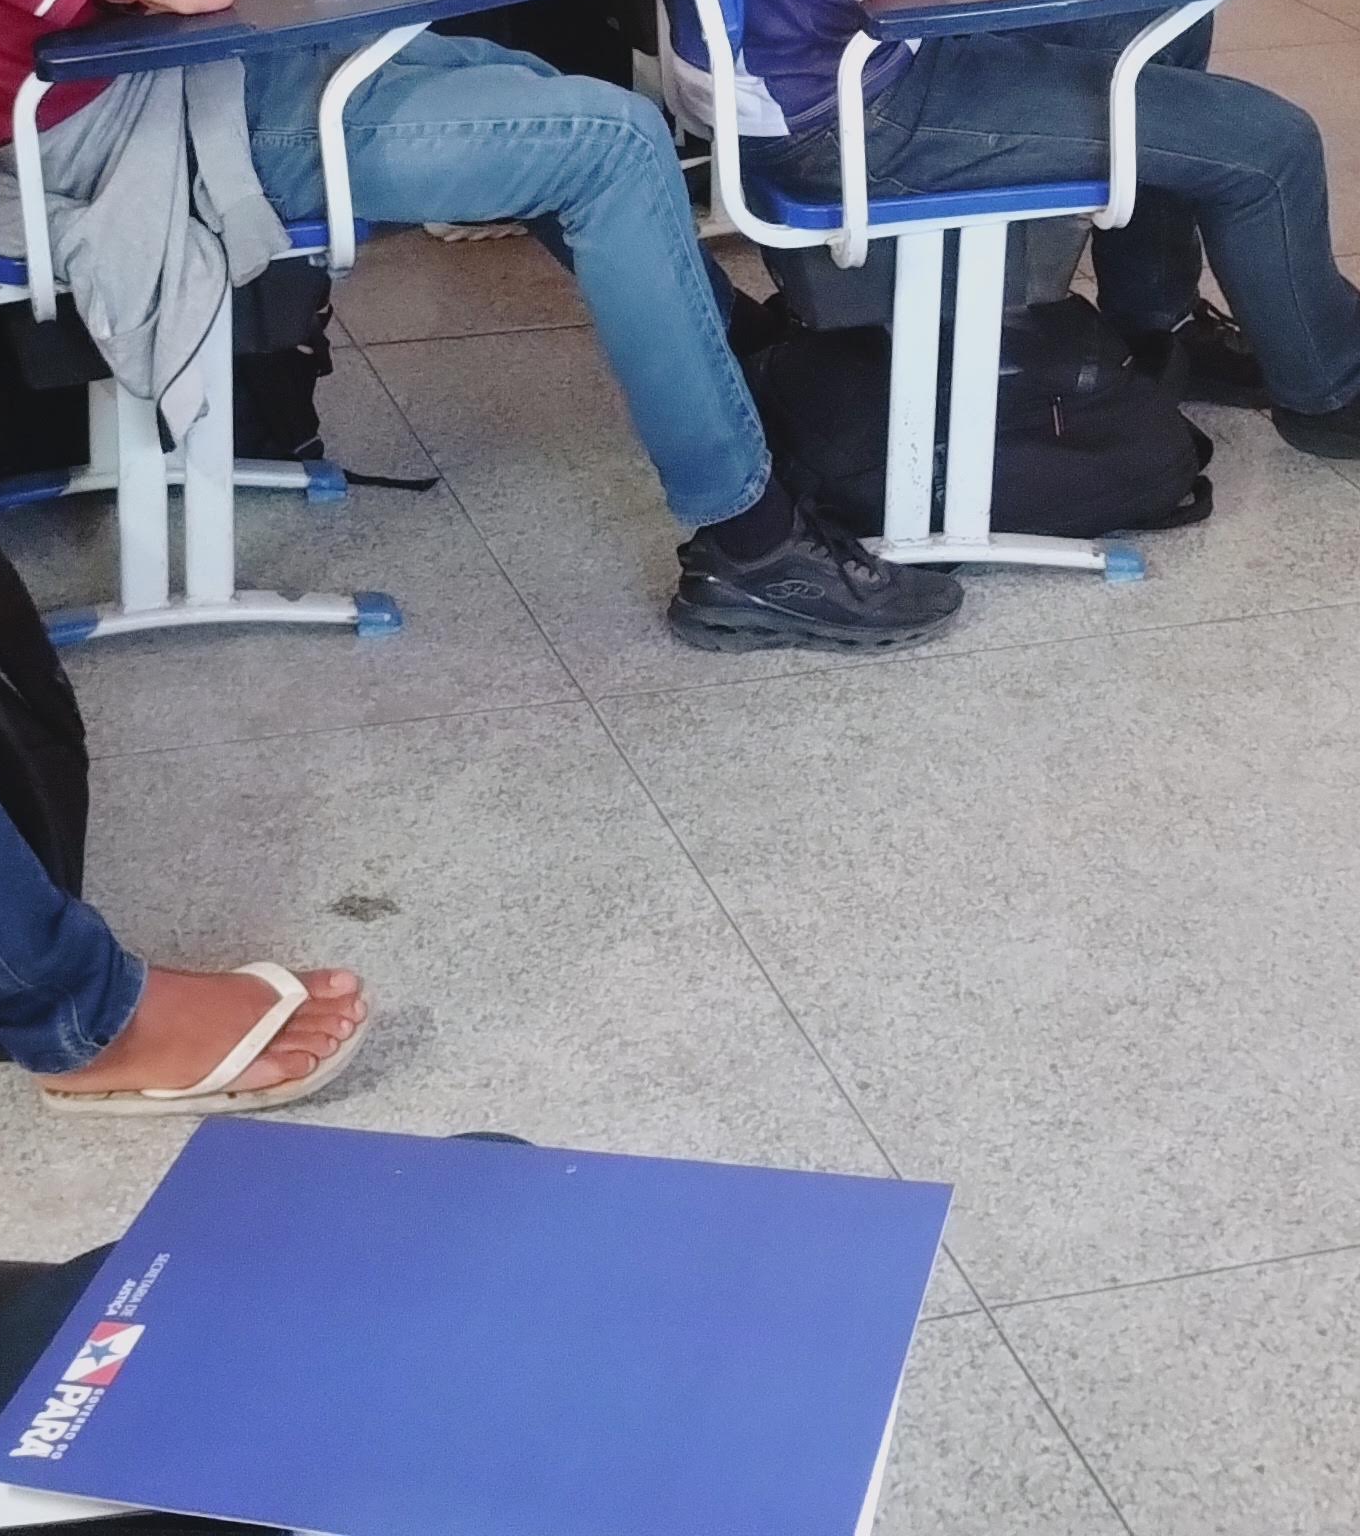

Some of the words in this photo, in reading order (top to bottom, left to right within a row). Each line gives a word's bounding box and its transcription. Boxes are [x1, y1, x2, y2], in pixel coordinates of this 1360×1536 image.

[105, 1278, 137, 1316] JUSTIÇA
[131, 1252, 171, 1305] SECRETARIA
[119, 1303, 140, 1318] DE
[63, 1387, 105, 1441] GOVERNO
